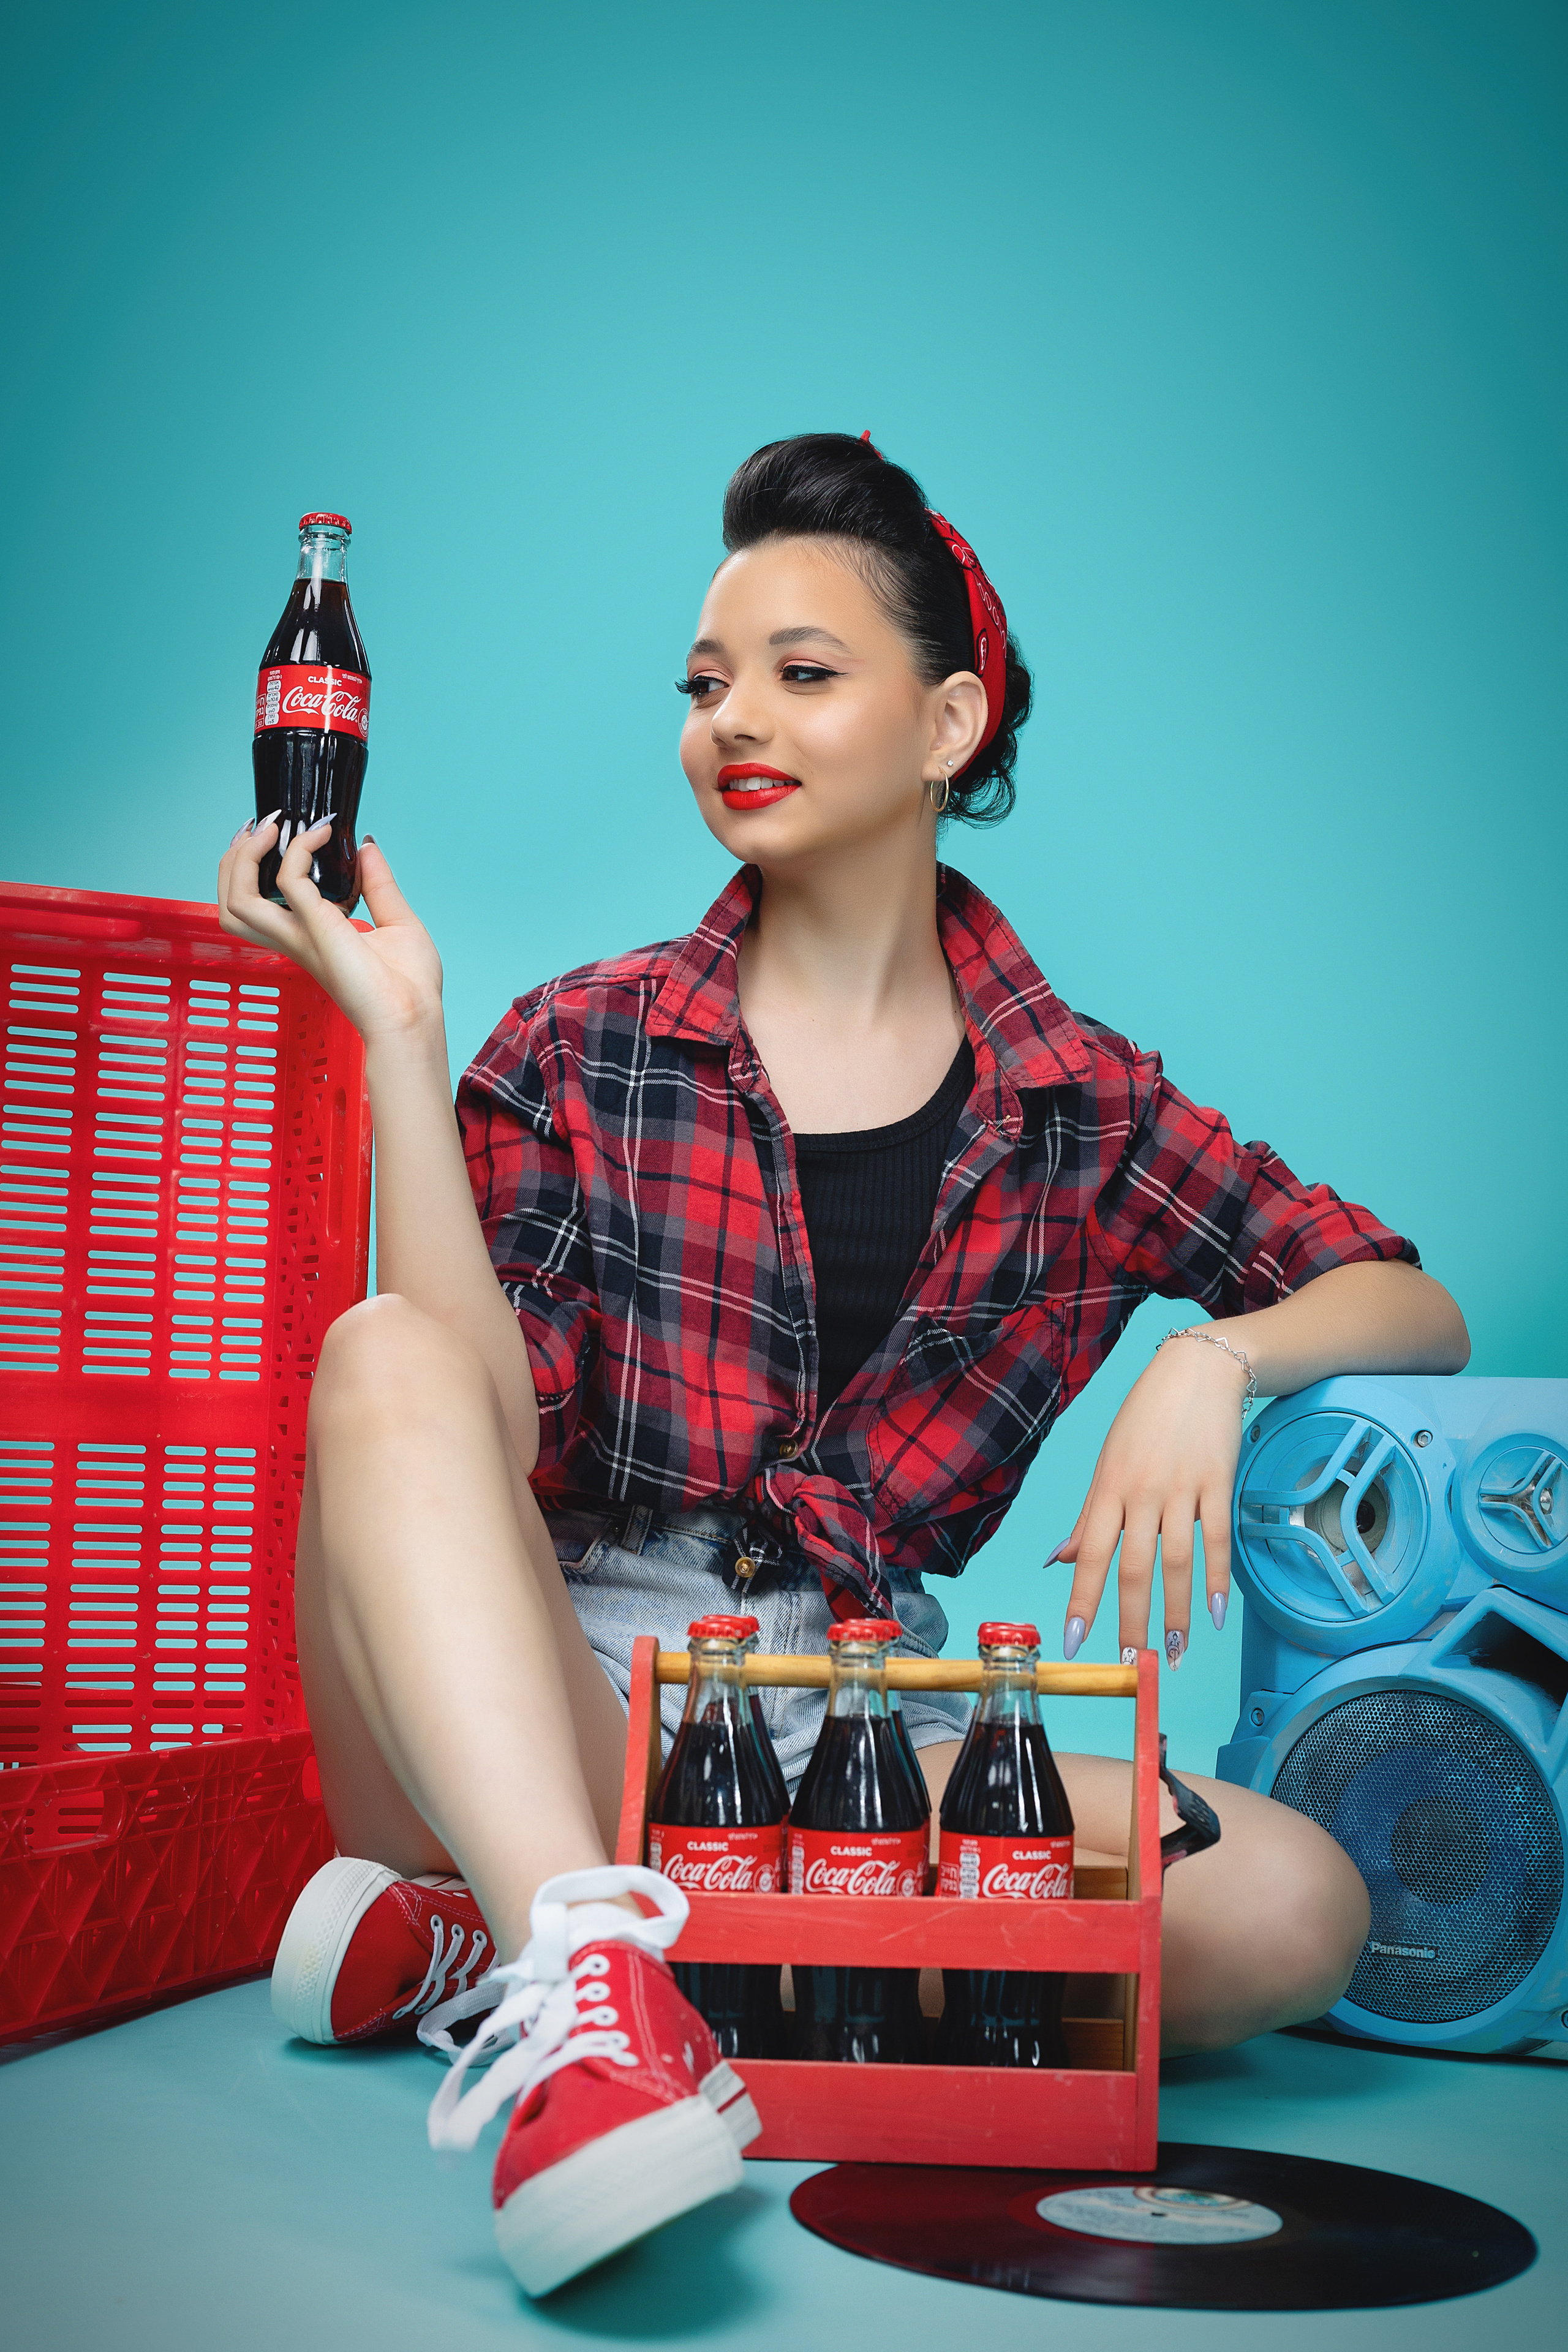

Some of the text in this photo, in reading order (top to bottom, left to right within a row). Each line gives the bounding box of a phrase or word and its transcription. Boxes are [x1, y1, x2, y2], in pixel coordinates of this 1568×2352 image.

[307, 676, 342, 687] CLASSIC
[282, 686, 361, 722] Coca-Cola
[687, 1841, 729, 1852] CLASSIC
[830, 1845, 872, 1856] CLASSIC
[1012, 1850, 1052, 1860] CLASSIC
[663, 1853, 758, 1890] Coca-Cola
[805, 1858, 901, 1895] Coca-Cola
[982, 1863, 1070, 1899] Coca-Cola
[1371, 1942, 1436, 1959] Panasonic
